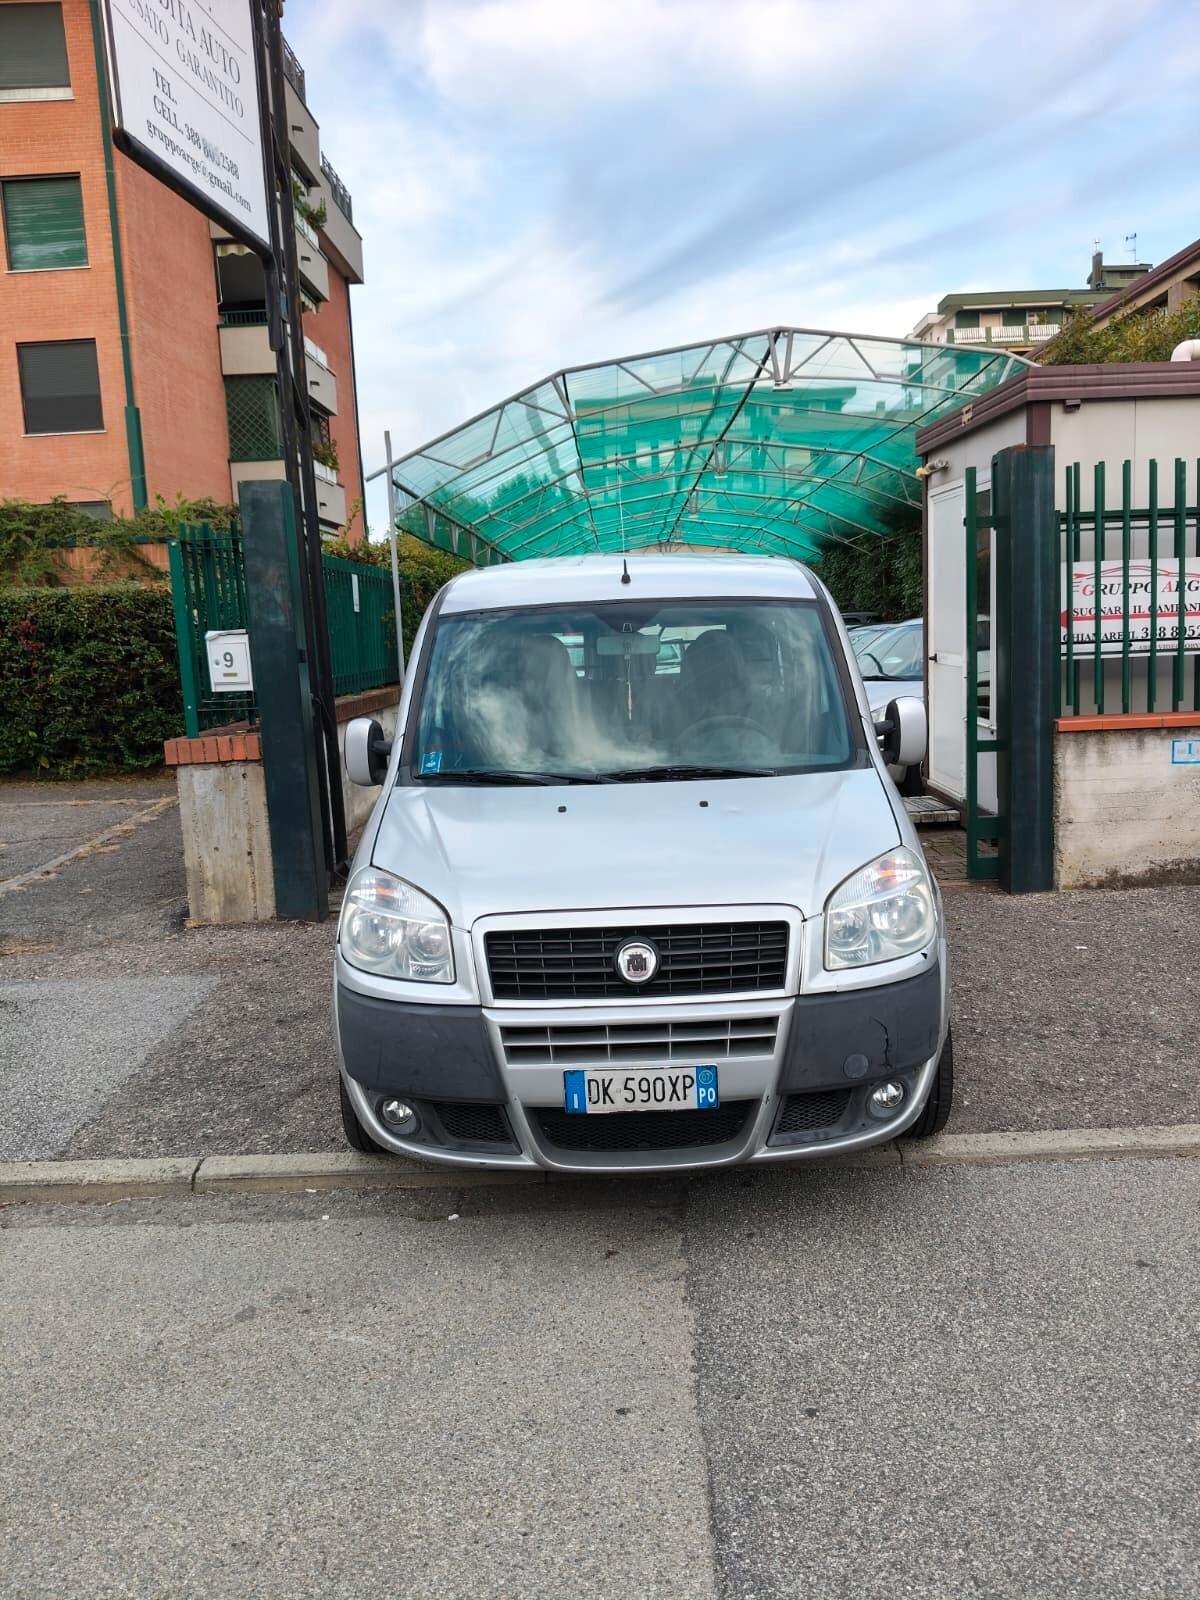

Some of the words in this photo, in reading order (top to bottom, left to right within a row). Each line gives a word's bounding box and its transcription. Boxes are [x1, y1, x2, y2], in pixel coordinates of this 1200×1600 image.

[200, 25, 241, 84] AUTO
[152, 67, 178, 104] TEL.
[176, 38, 244, 118] GARANTITO
[1081, 582, 1154, 597] GRUPO
[223, 651, 234, 669] 9
[587, 1078, 615, 1105] DK
[623, 1074, 695, 1104] 590XP
[699, 1087, 716, 1103] PO
